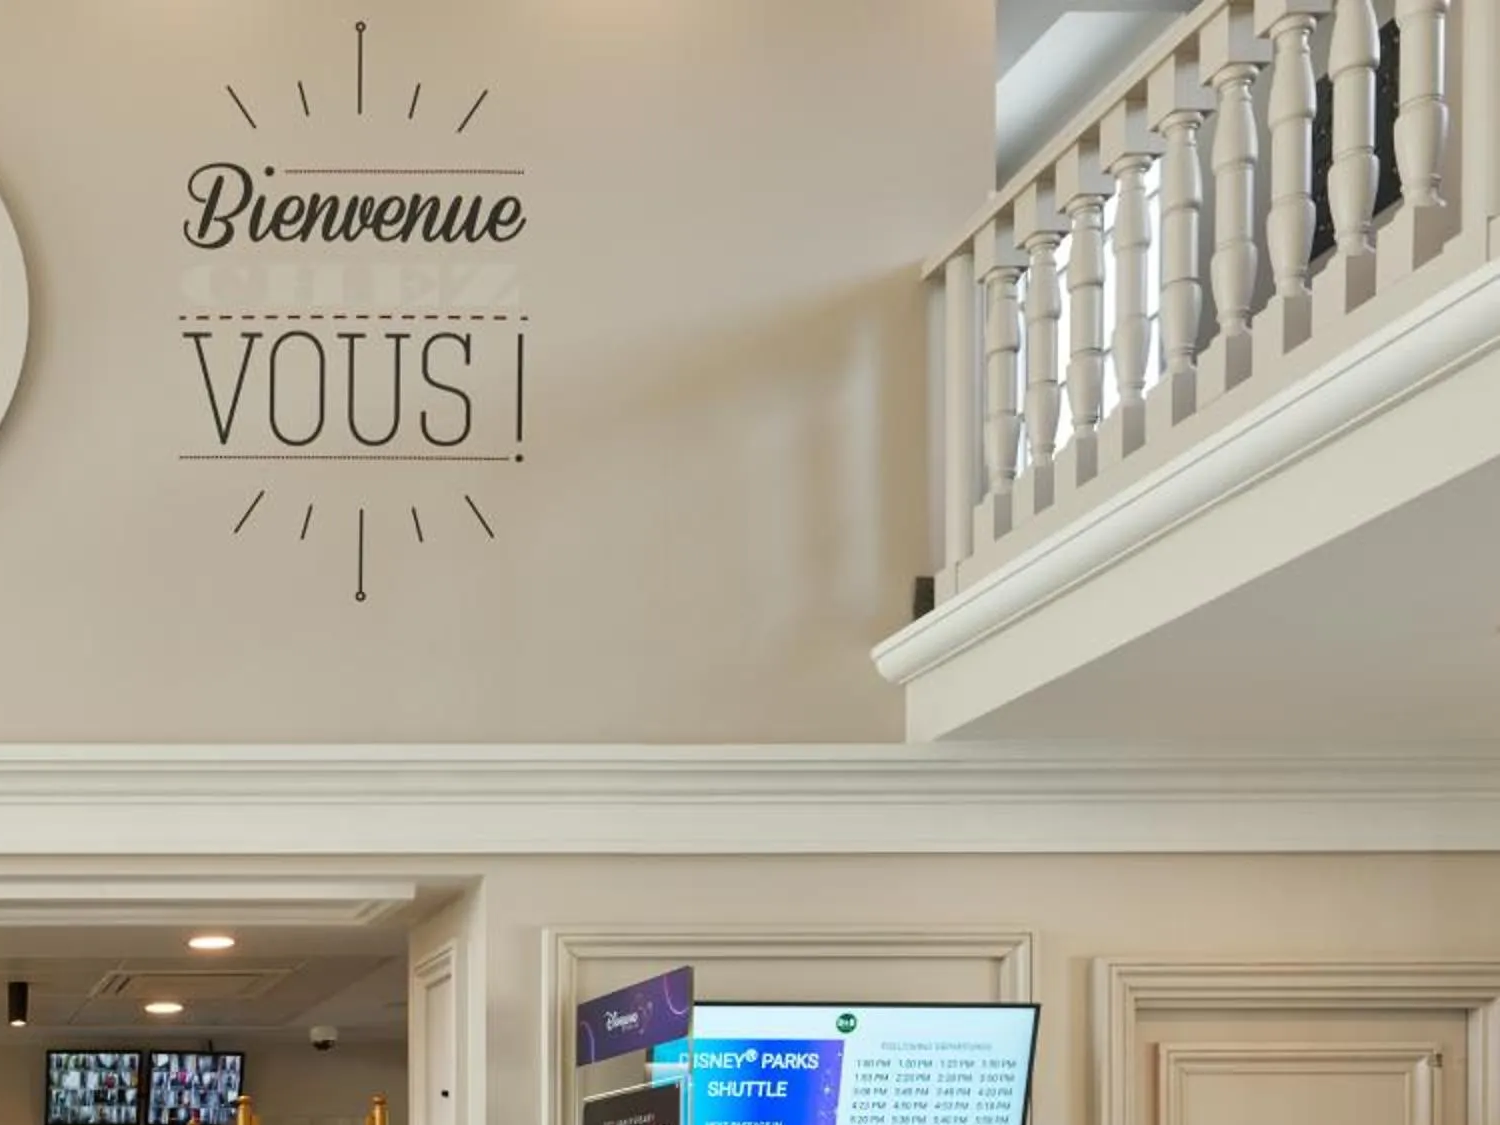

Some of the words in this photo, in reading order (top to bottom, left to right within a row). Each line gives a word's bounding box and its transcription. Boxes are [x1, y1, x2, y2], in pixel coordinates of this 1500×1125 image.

[182, 161, 527, 251] Bienvenue
[761, 1053, 820, 1069] PARKS
[707, 1081, 788, 1098] SHUTTLE
